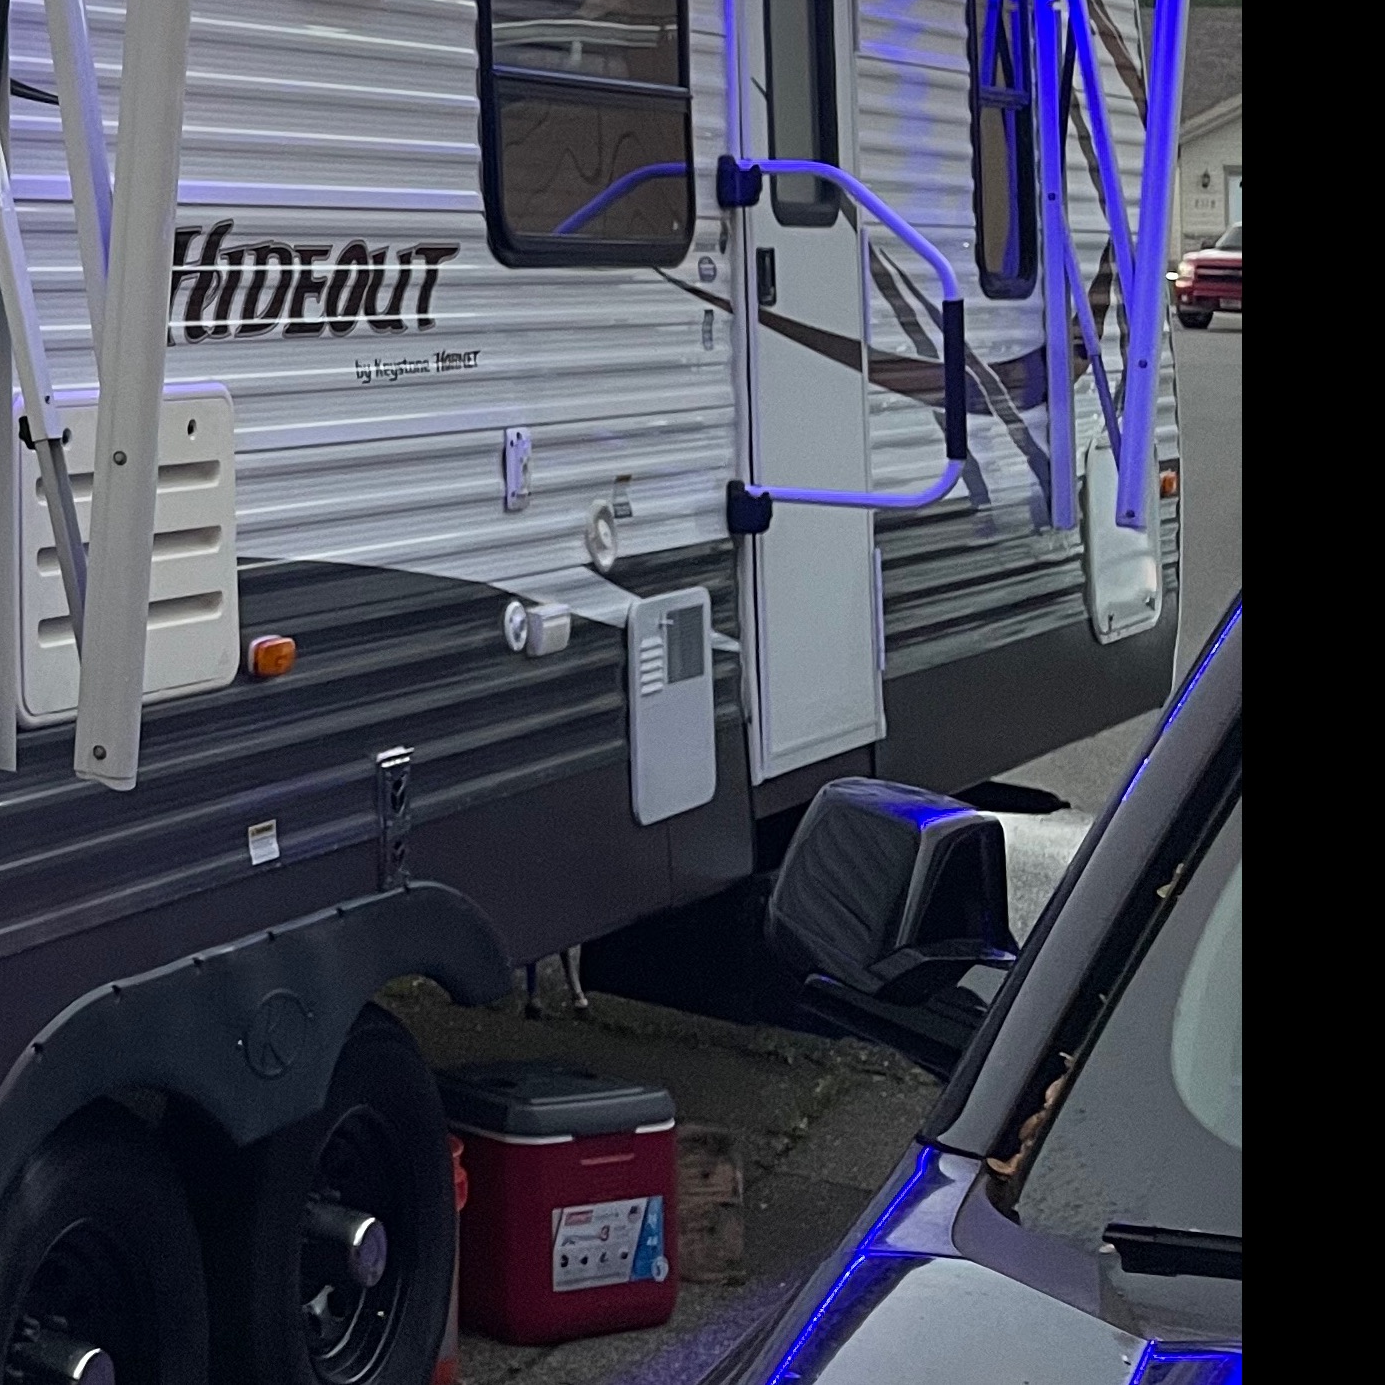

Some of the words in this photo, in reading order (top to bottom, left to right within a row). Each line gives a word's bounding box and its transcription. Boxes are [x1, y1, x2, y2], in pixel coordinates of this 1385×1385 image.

[167, 218, 461, 345] HIDEOUT
[355, 359, 372, 384] by
[374, 358, 430, 382] Keystone
